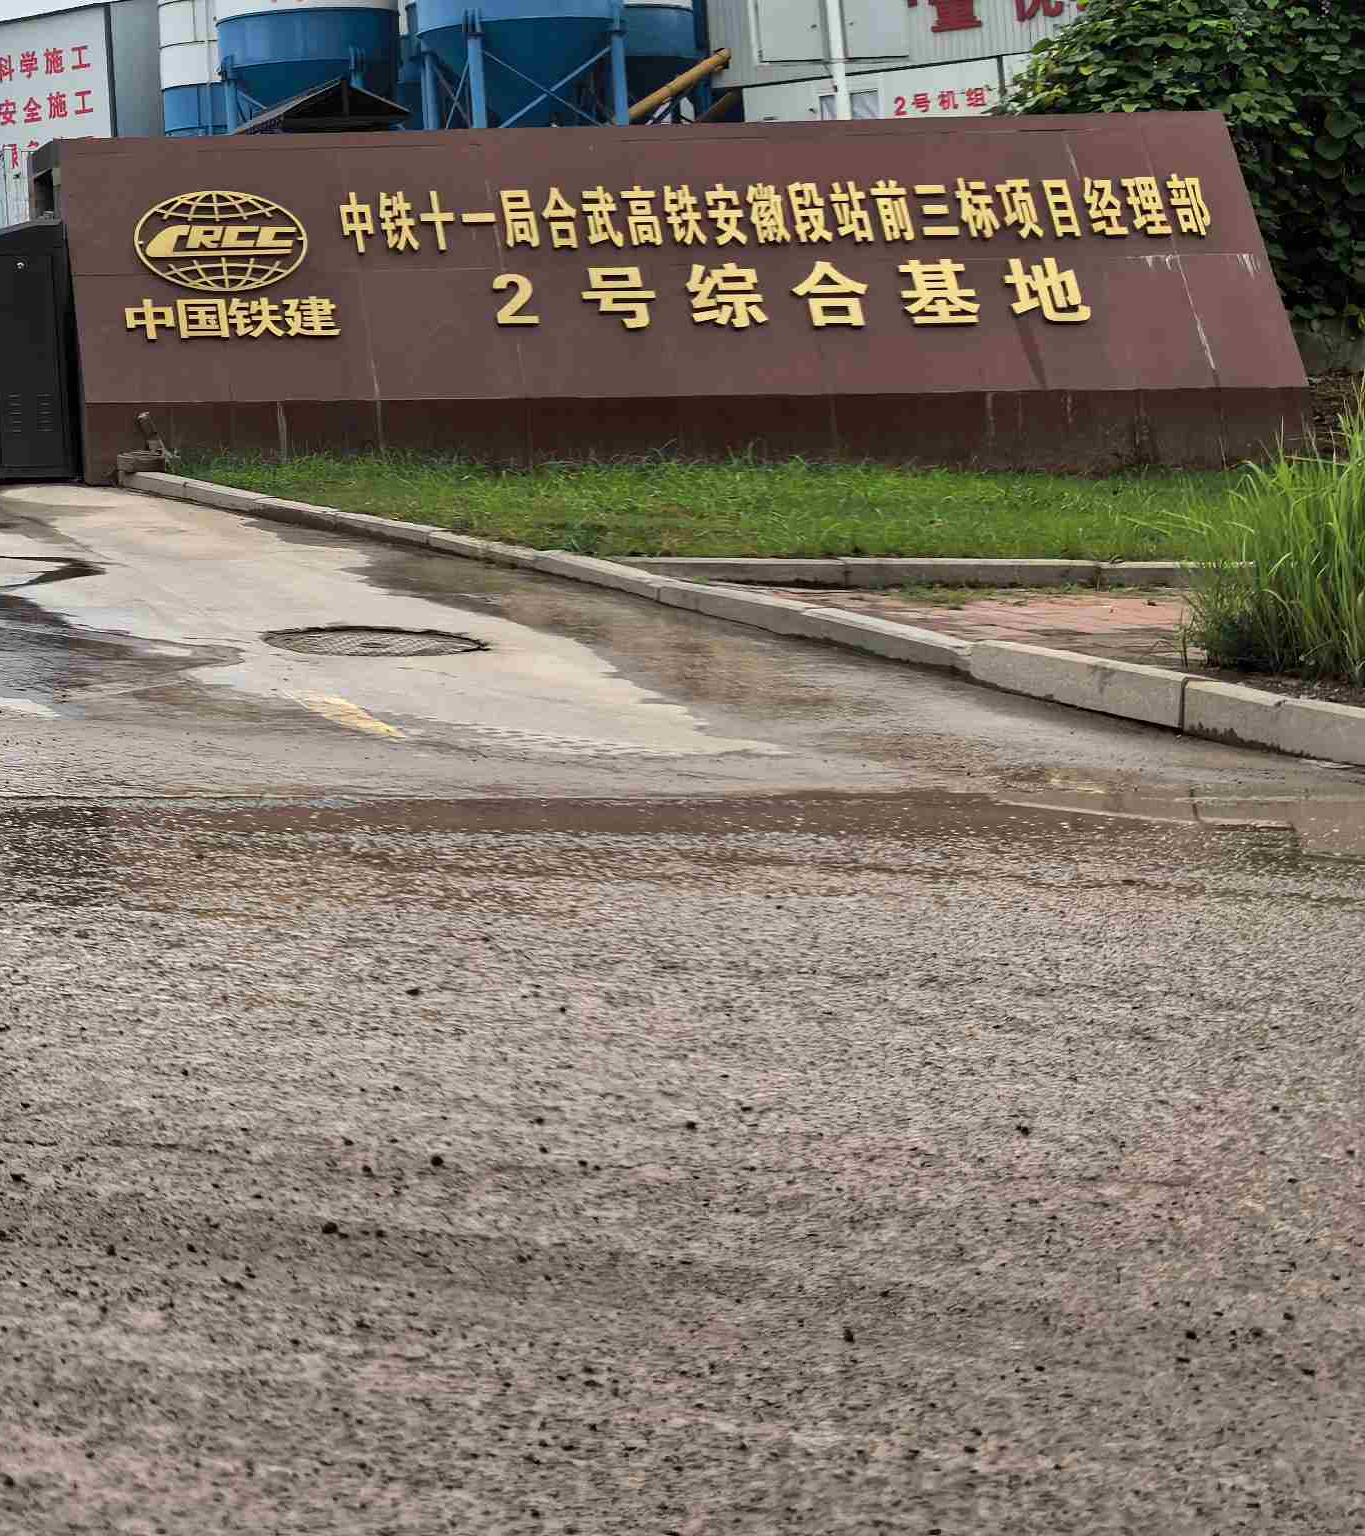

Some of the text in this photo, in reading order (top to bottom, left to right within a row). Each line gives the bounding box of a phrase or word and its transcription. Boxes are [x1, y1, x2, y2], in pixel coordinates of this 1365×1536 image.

[893, 87, 987, 116] 2号机组
[339, 173, 1211, 254] 中铁十一局合武高铁安徽段站前三标项目经理部
[145, 224, 297, 258] CRCC
[492, 257, 1092, 329] 2号综合基地
[124, 295, 342, 340] 中国铁建
